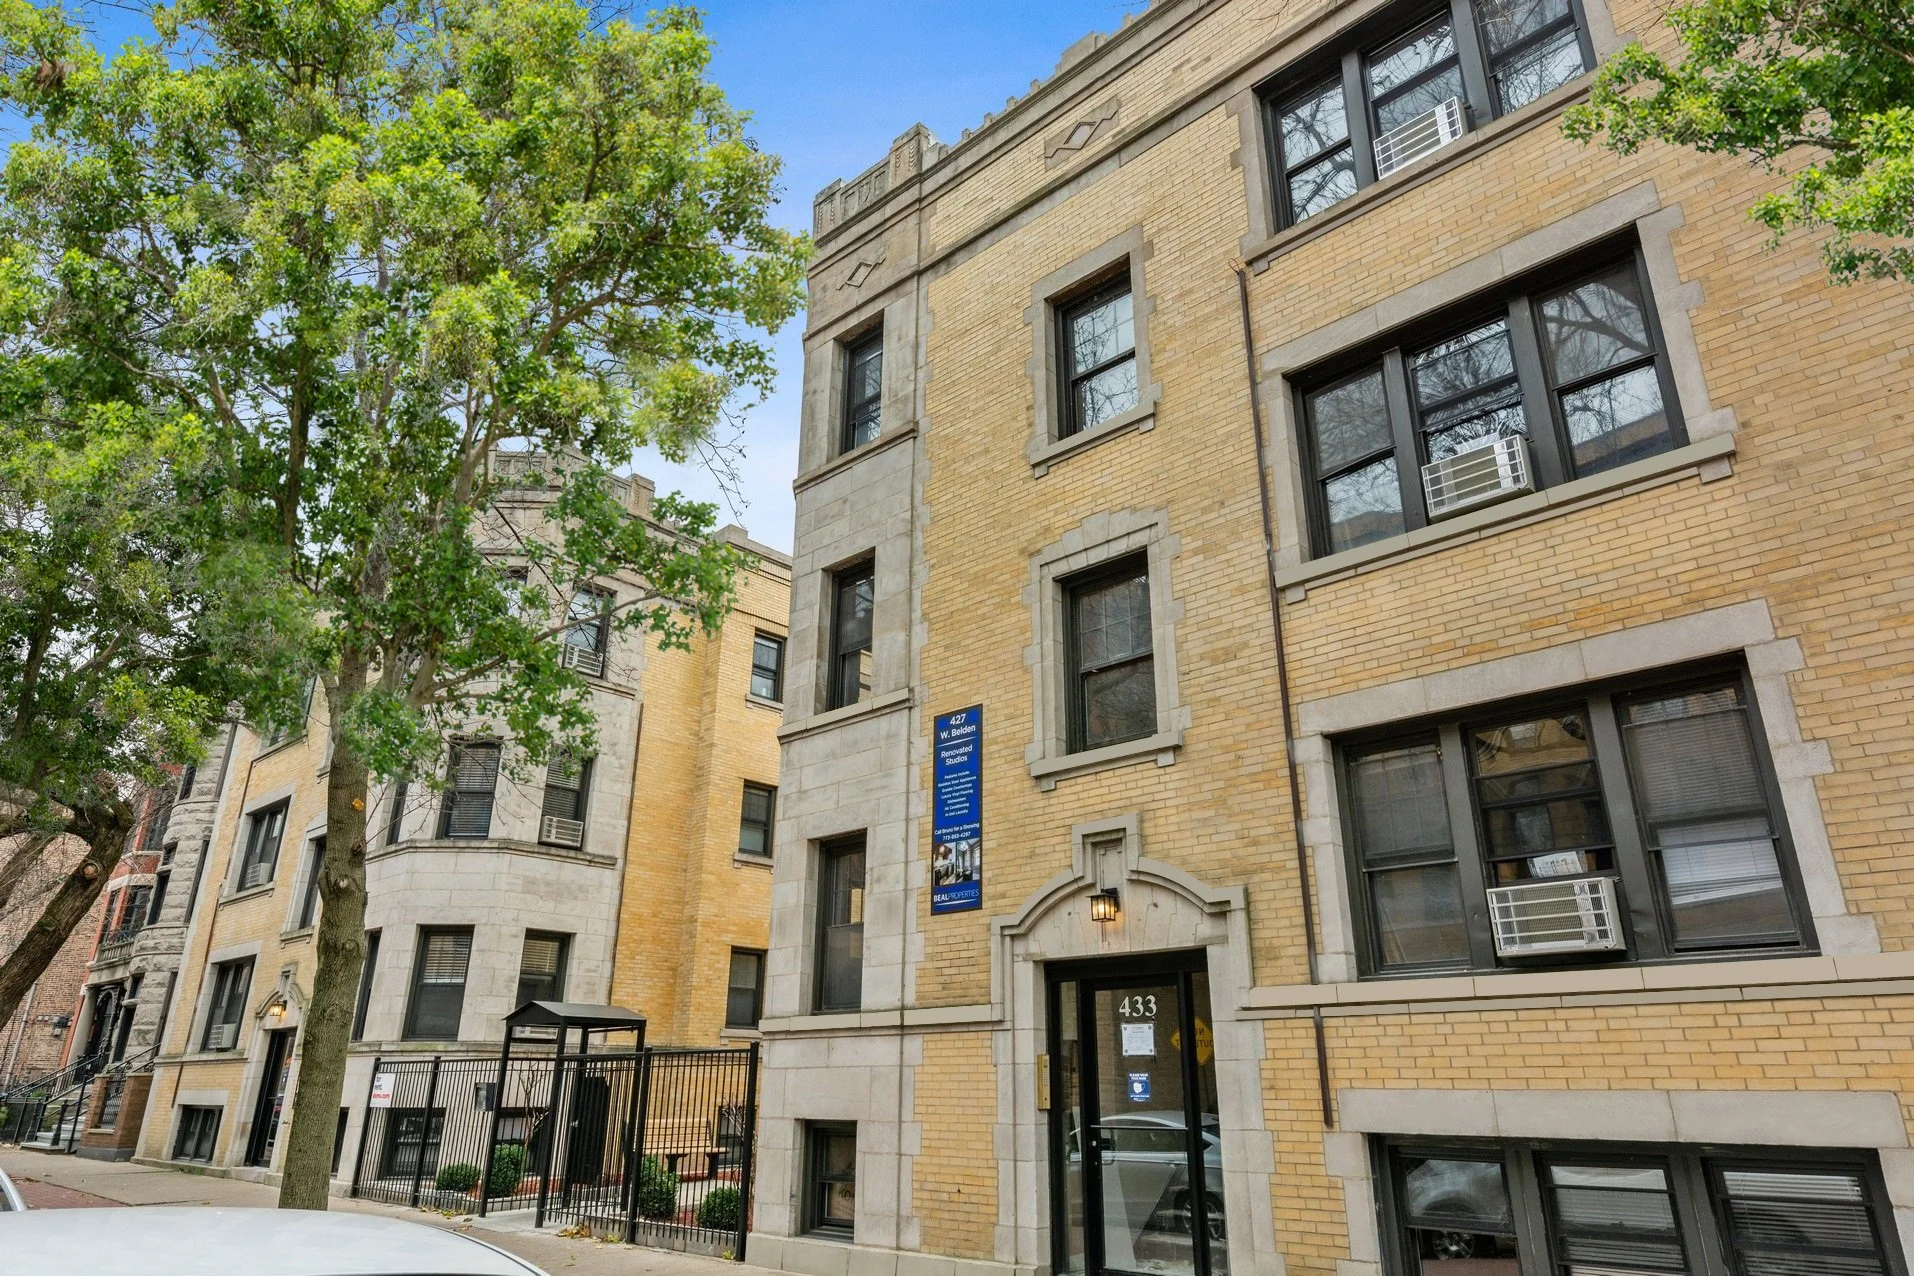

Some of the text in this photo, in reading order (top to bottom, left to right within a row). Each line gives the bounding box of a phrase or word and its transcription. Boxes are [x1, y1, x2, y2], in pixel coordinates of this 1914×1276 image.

[949, 713, 966, 726] 427
[940, 725, 976, 740] W. Belden
[941, 744, 972, 758] Renovated
[945, 755, 968, 766] Studios
[1118, 995, 1157, 1017] 433
